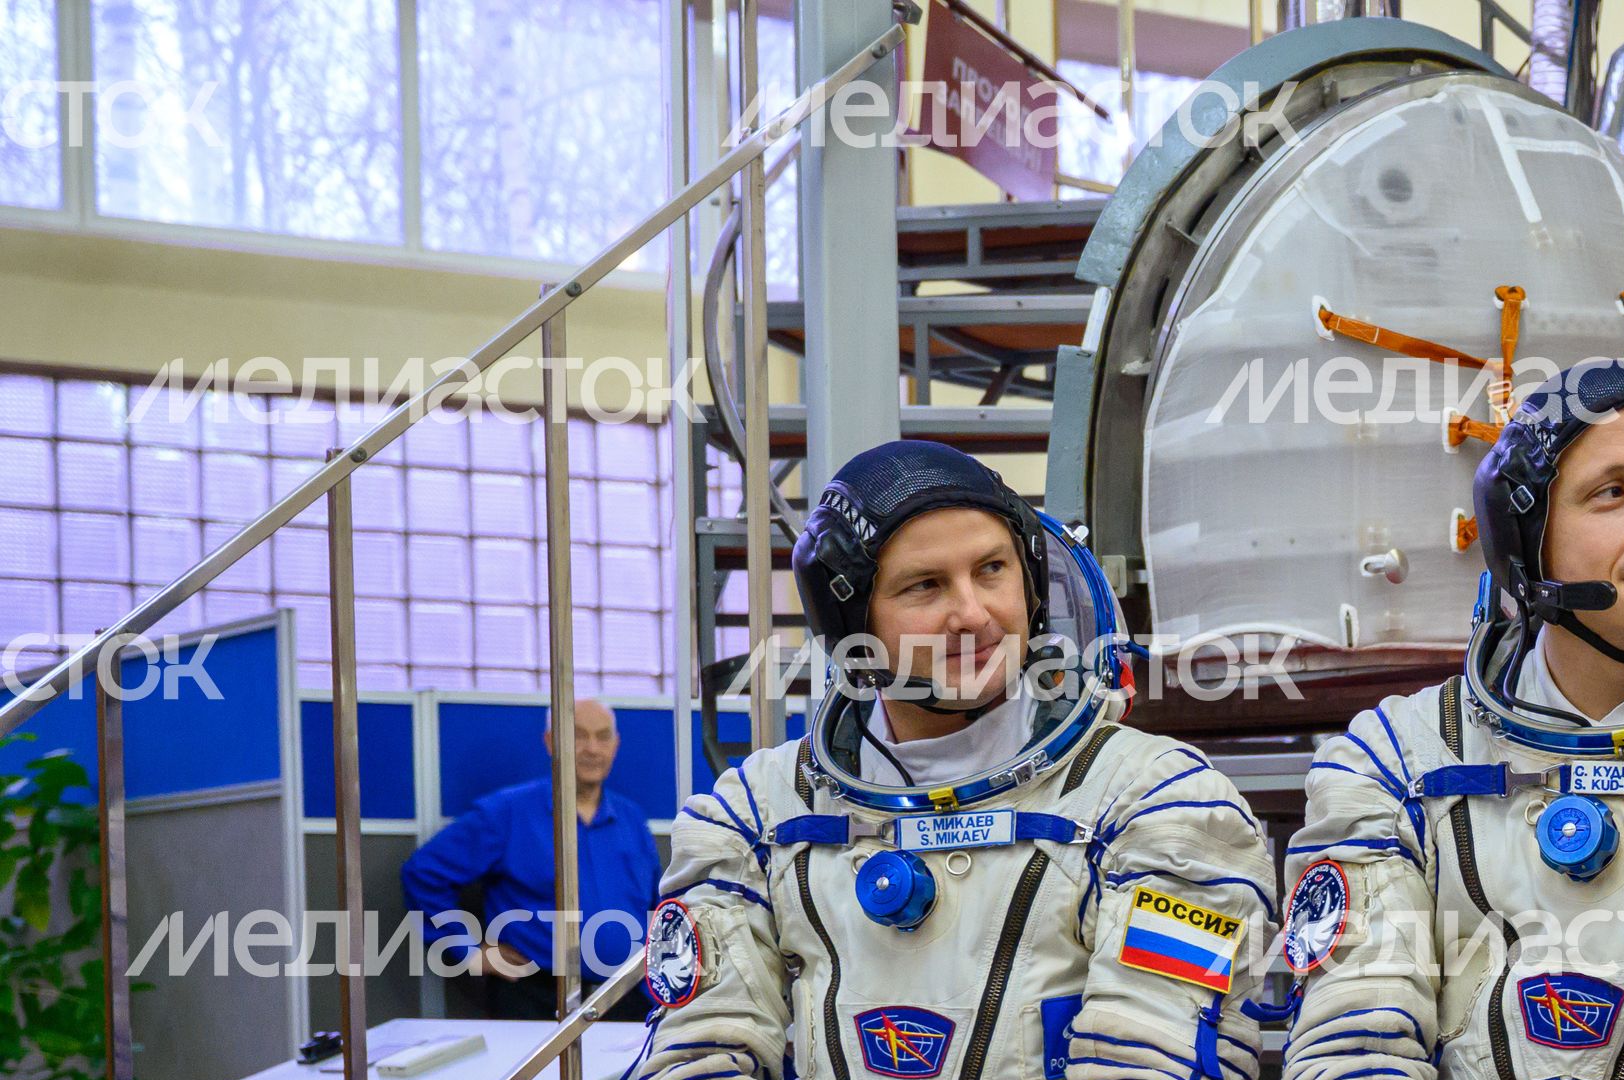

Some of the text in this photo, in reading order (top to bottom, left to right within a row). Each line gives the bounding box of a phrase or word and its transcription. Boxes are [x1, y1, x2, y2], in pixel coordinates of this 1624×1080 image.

[1574, 765, 1588, 777] С.
[1574, 779, 1586, 790] S.
[916, 815, 994, 832] С. МИКАЕВ
[920, 828, 991, 846] S. MIKAEV
[1136, 891, 1241, 939] РОССИЯ
